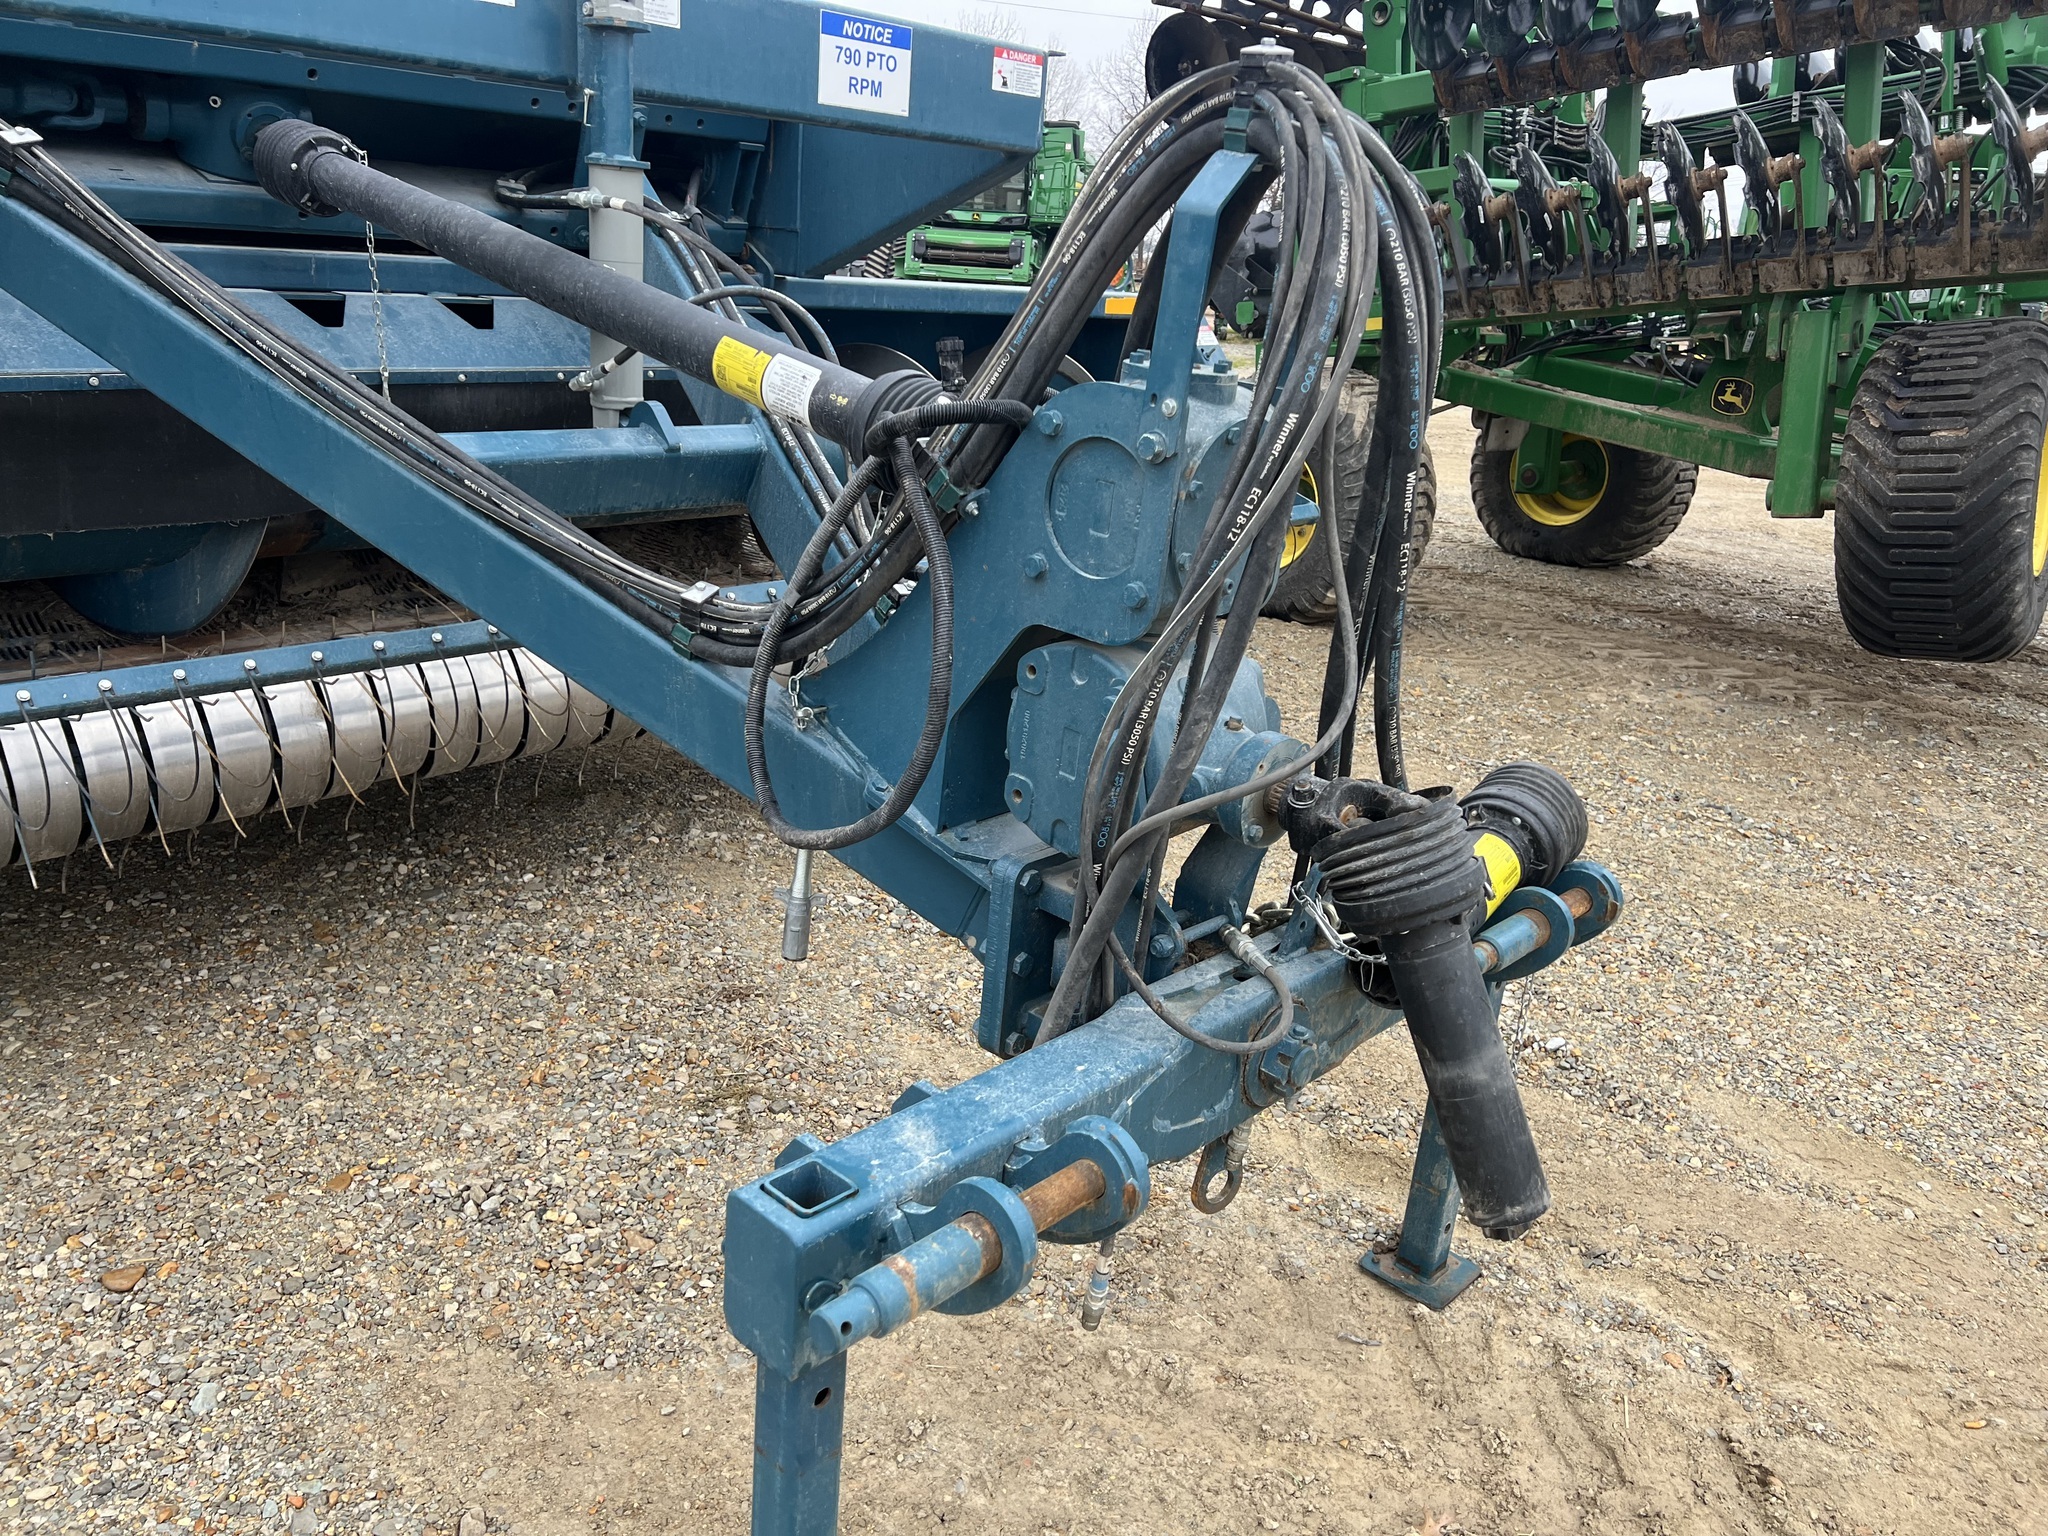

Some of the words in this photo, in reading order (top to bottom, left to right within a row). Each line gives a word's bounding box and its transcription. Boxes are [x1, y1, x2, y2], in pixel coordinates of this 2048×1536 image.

[842, 20, 893, 44] NOTICE
[835, 45, 861, 66] 790
[866, 51, 897, 72] PTO
[1009, 50, 1037, 64] DANGER
[849, 76, 883, 98] RPM
[1096, 187, 1118, 213] Winner
[1340, 189, 1350, 208] 210
[1342, 209, 1350, 231] BAR
[1062, 230, 1086, 264] EC118-06
[1338, 232, 1349, 264] (3050
[1390, 240, 1404, 261] 210
[1334, 264, 1346, 288] PSI)
[1396, 262, 1410, 286] BAR
[996, 359, 1006, 372] 210
[989, 371, 1000, 385] BAR
[1271, 413, 1299, 458] Winner
[1404, 470, 1417, 513] Winner
[884, 510, 904, 536] EC118-06
[1227, 487, 1262, 541] EC118-12
[1362, 552, 1377, 591] Winner
[1396, 542, 1410, 592] EC118-12
[1148, 680, 1162, 698] 210
[1139, 700, 1154, 719] BAR
[1128, 720, 1146, 746] (3050
[1389, 728, 1398, 744] BAR
[1121, 746, 1135, 765] PSI)
